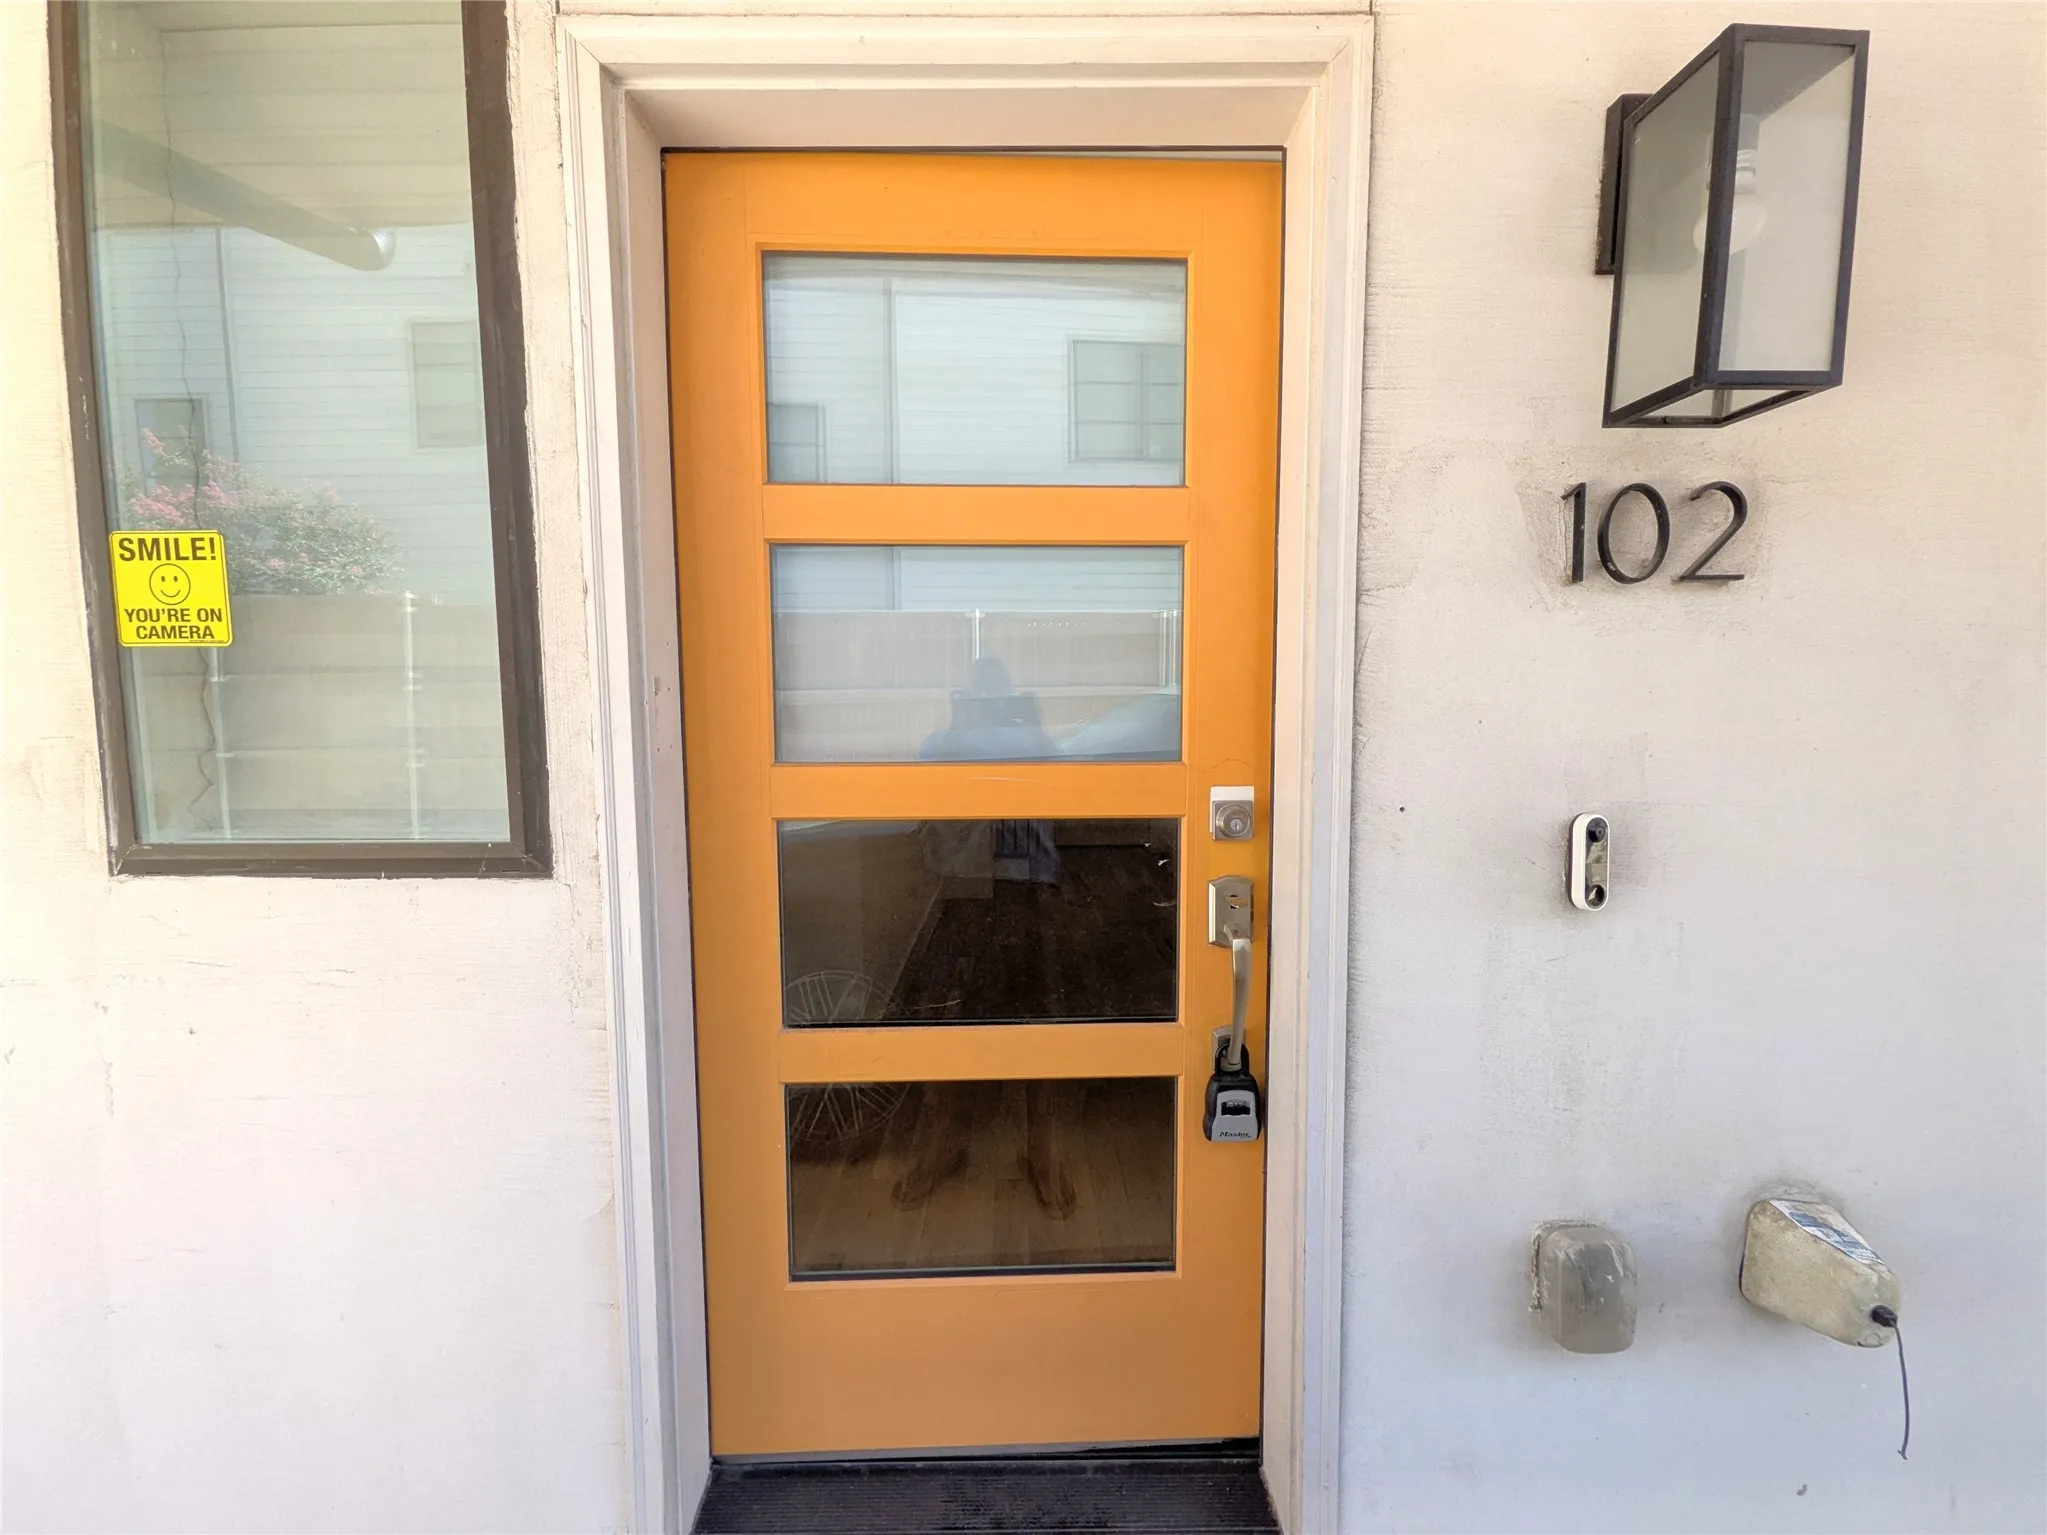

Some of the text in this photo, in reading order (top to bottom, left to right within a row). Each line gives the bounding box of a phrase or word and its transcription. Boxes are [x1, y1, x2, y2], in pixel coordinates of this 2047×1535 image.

[1560, 480, 1748, 585] 102
[118, 537, 216, 561] SMILE!
[124, 608, 223, 622] YOU'RE ON
[136, 625, 215, 640] CAMERA
